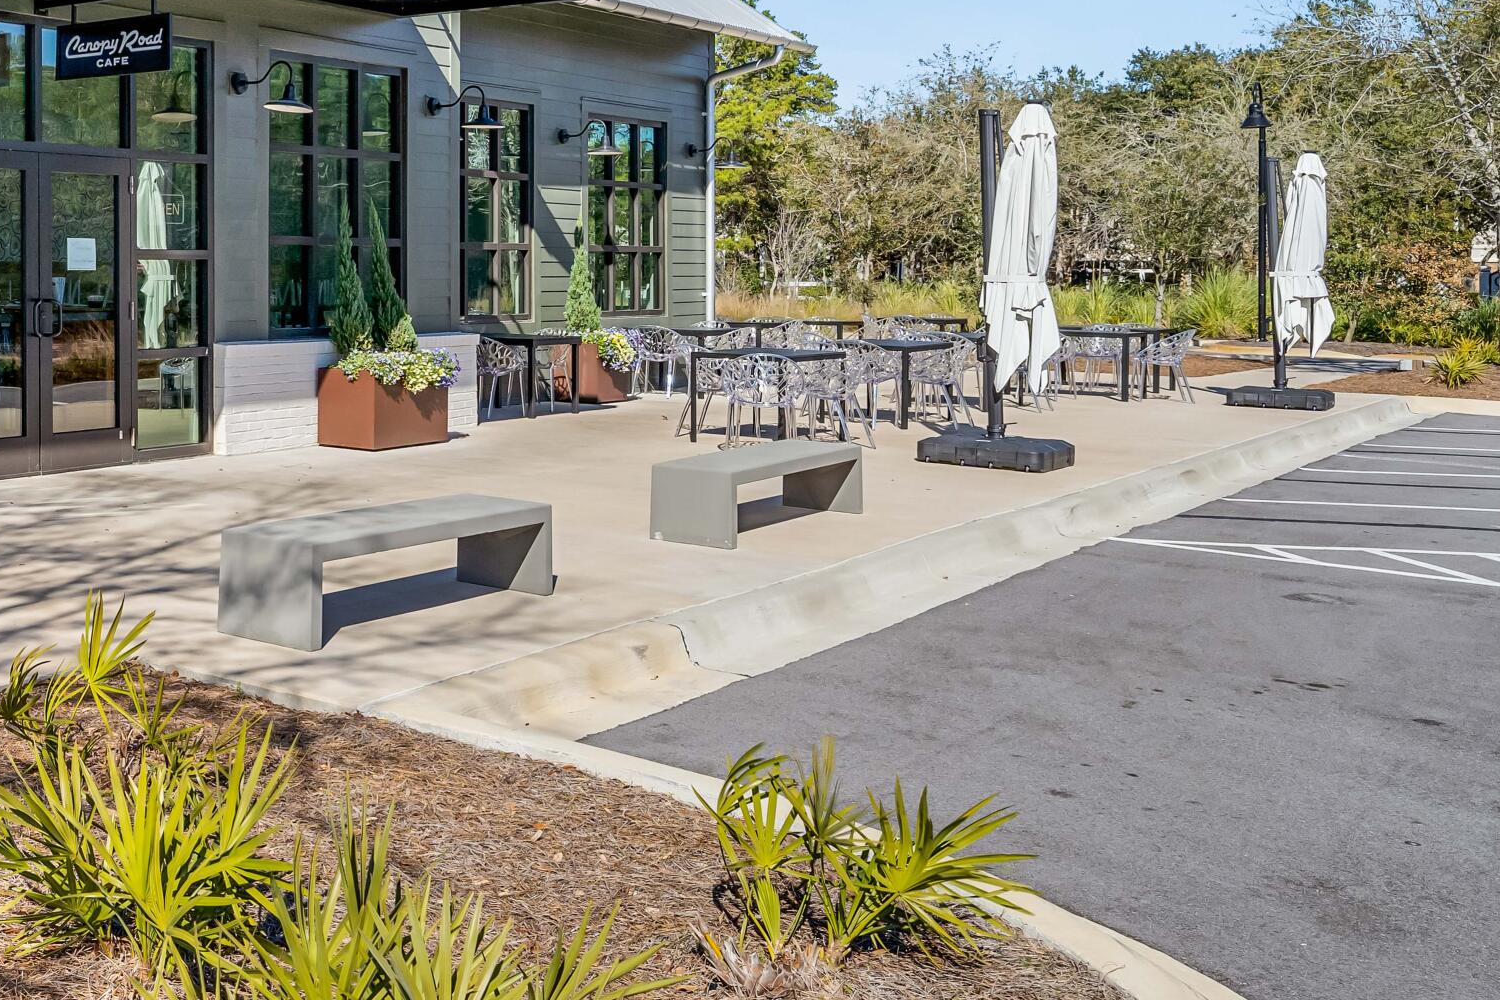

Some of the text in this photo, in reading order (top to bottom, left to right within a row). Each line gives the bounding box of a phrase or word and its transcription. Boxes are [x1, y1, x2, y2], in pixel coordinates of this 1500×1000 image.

[65, 27, 163, 59] Canopy Road
[96, 56, 129, 68] CAFE
[165, 202, 180, 216] EN
